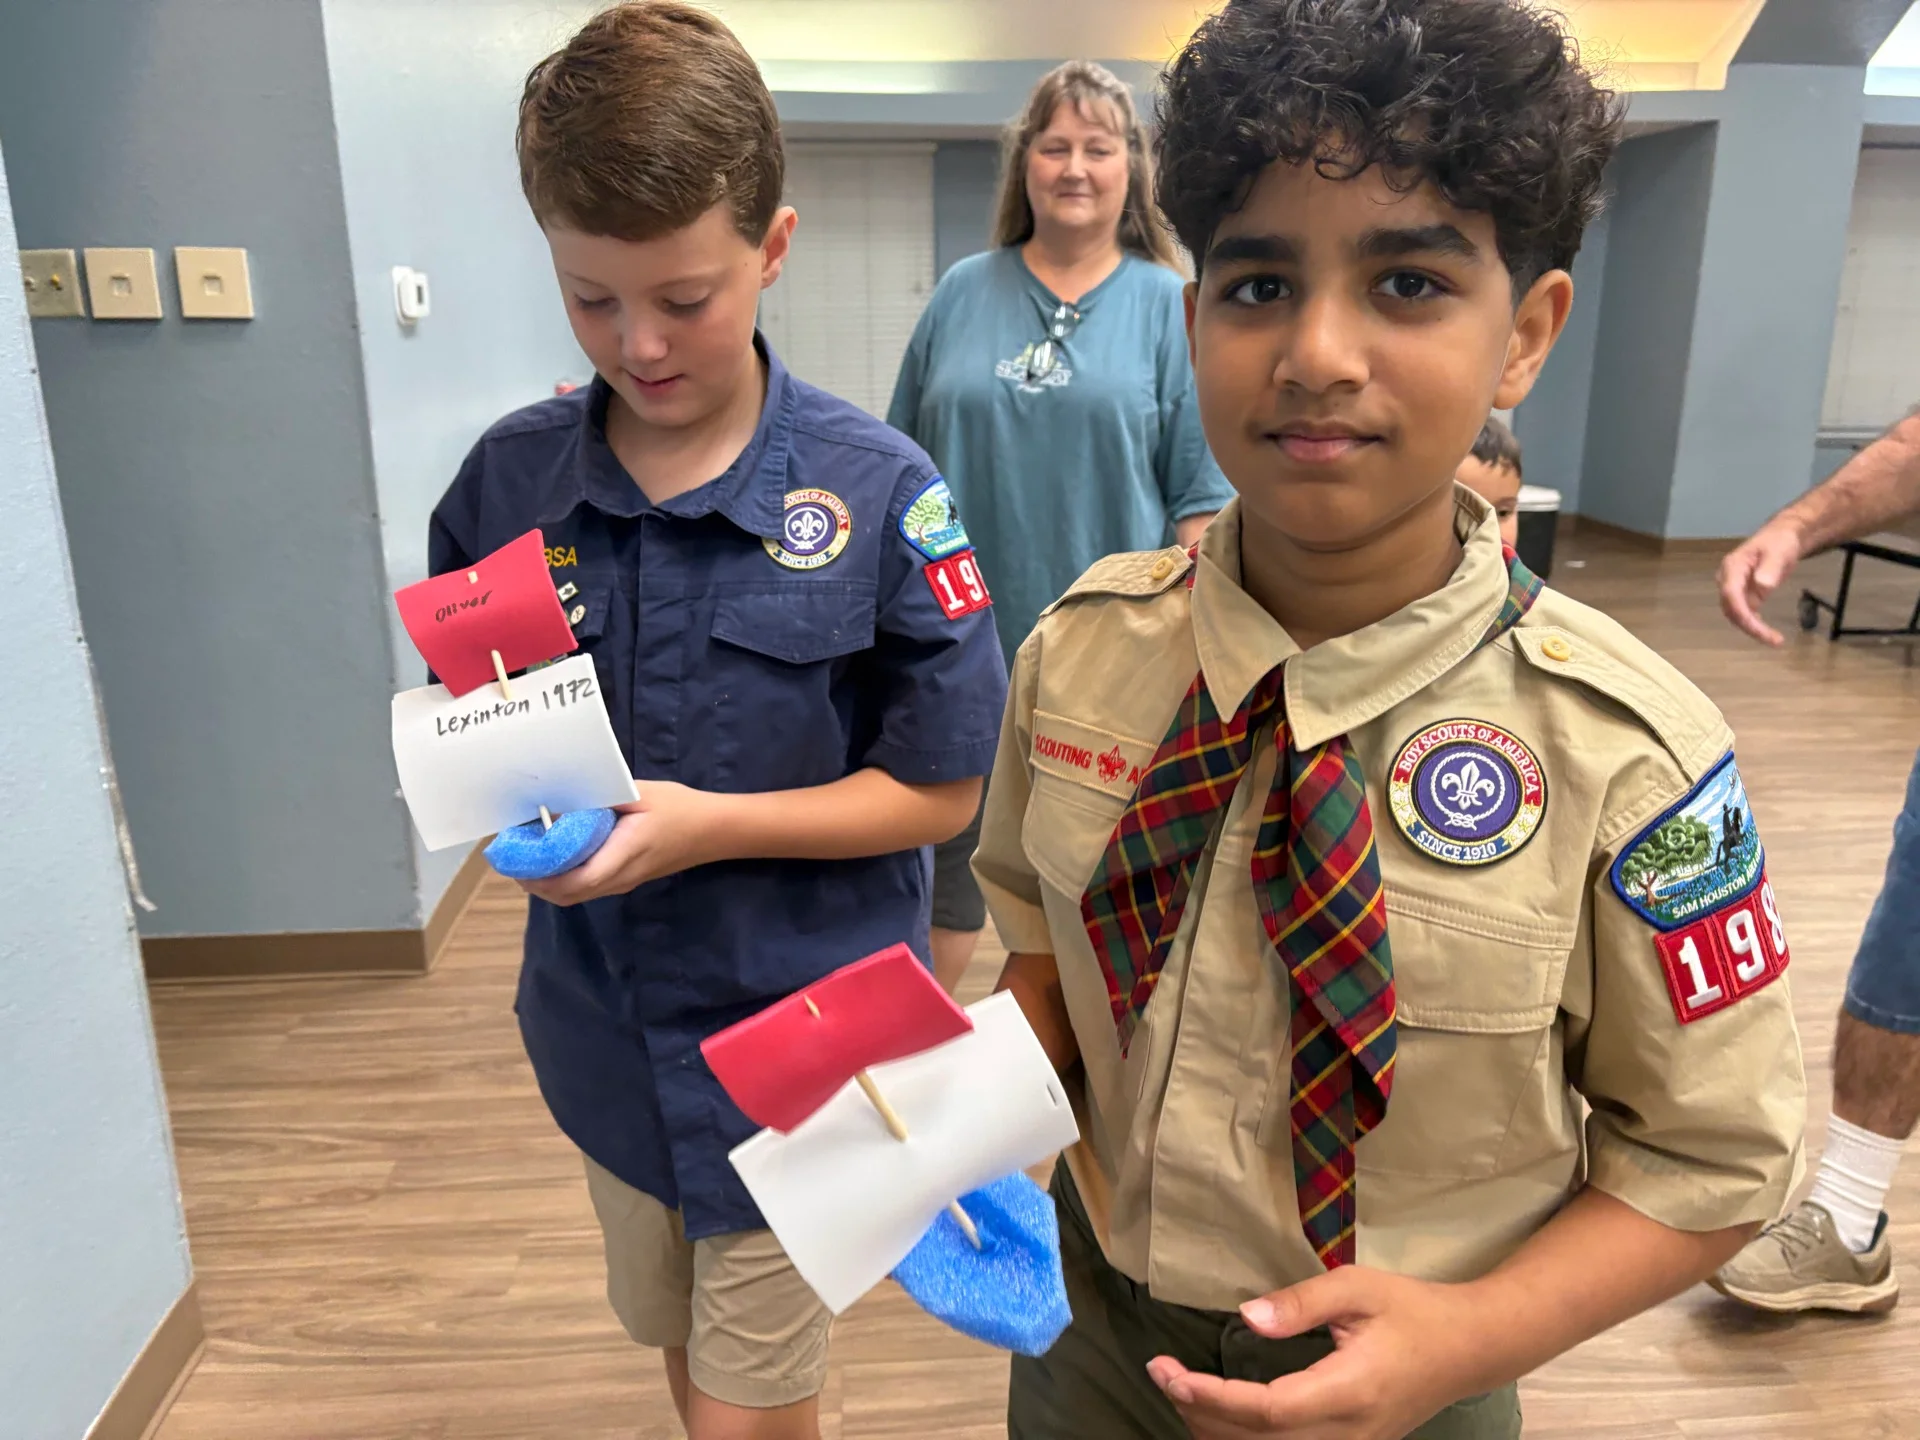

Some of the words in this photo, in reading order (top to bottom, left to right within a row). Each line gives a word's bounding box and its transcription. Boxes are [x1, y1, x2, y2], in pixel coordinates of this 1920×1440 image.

[436, 699, 530, 736] Lexinton
[542, 677, 596, 710] 1972
[1035, 733, 1093, 770] SCOUTING
[1399, 741, 1424, 773] BOY
[1420, 724, 1476, 750] SCOUTS
[1477, 728, 1495, 742] OF
[1489, 735, 1540, 796] AMERICA
[1416, 830, 1461, 860] SINCE
[1462, 842, 1497, 860] 1910
[1672, 899, 1699, 919] SAM
[1699, 873, 1747, 909] HOUSTON
